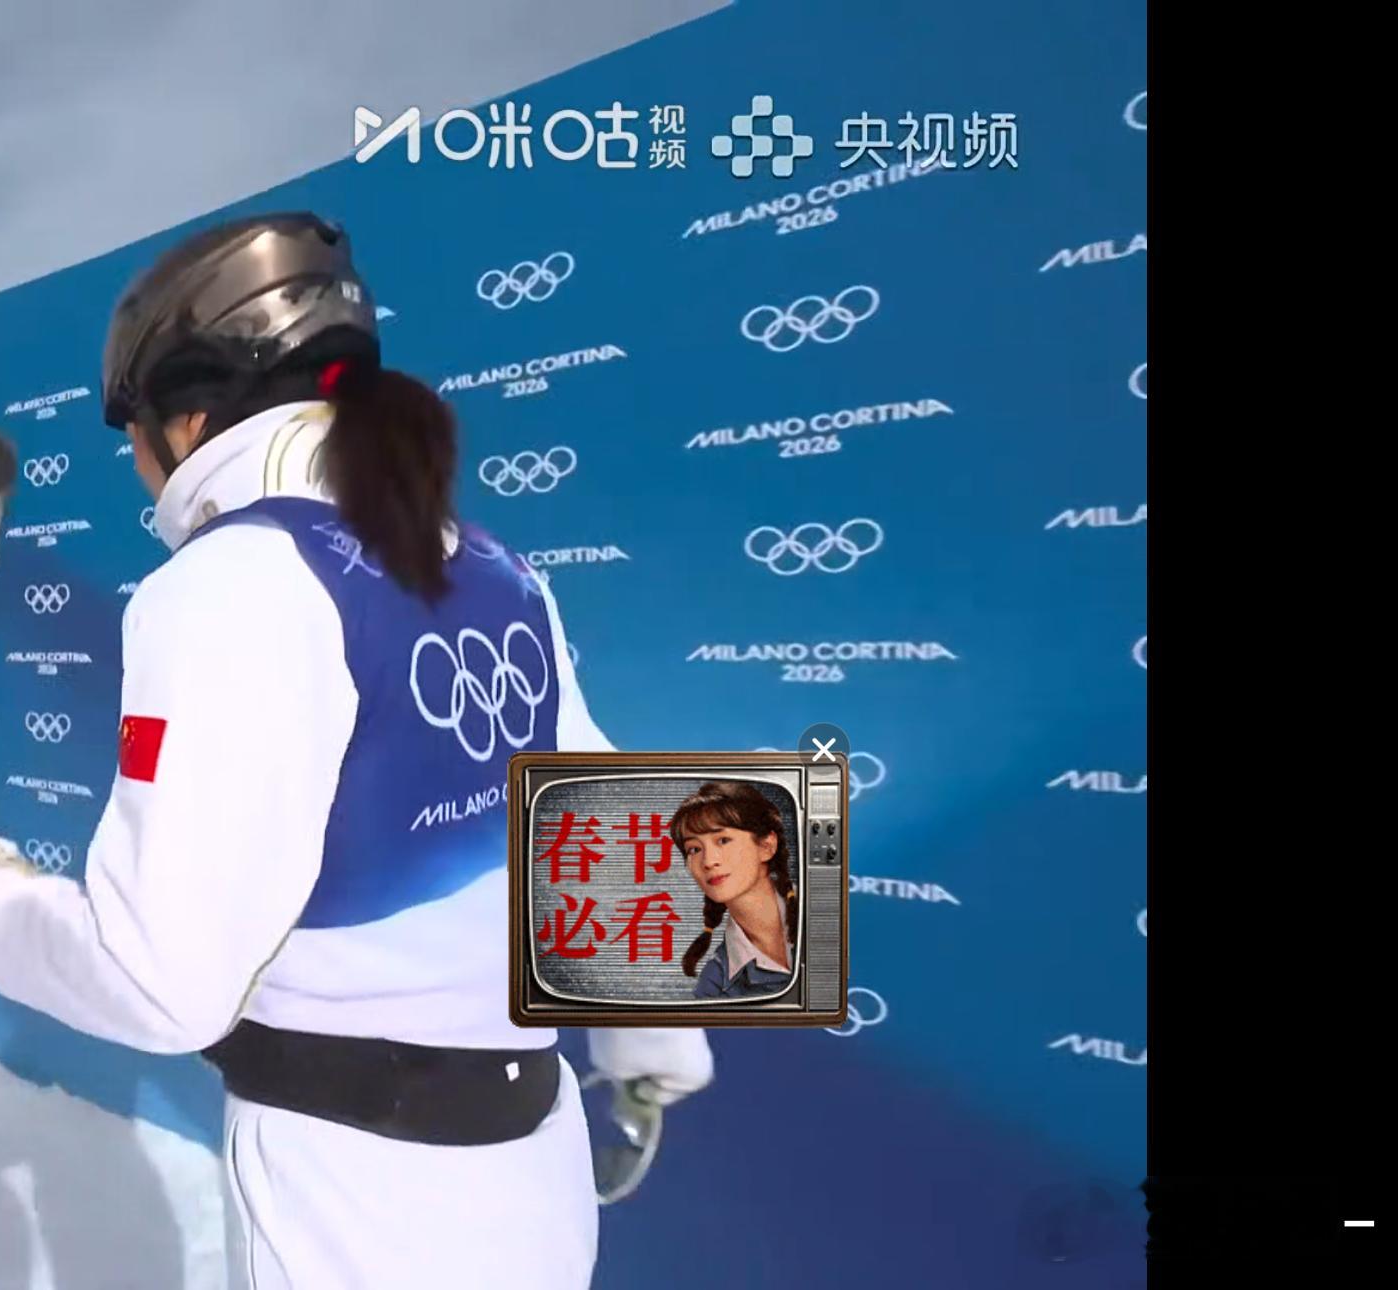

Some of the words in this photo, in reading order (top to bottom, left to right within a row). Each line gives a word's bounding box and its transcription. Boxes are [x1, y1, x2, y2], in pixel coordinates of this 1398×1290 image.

[682, 192, 802, 239] MILANO
[775, 205, 839, 236] 2026
[438, 363, 523, 394] MILANO
[525, 343, 628, 375] CORTINA
[684, 416, 806, 450] MILANO
[809, 398, 955, 433] CORTINA
[777, 434, 842, 458] 2026
[527, 545, 631, 567] CORTINA
[685, 642, 809, 662] MILANO
[812, 641, 958, 661] CORTINA
[781, 664, 846, 683] 2026
[410, 786, 500, 832] MILANO
[849, 873, 962, 906] ORTINA
